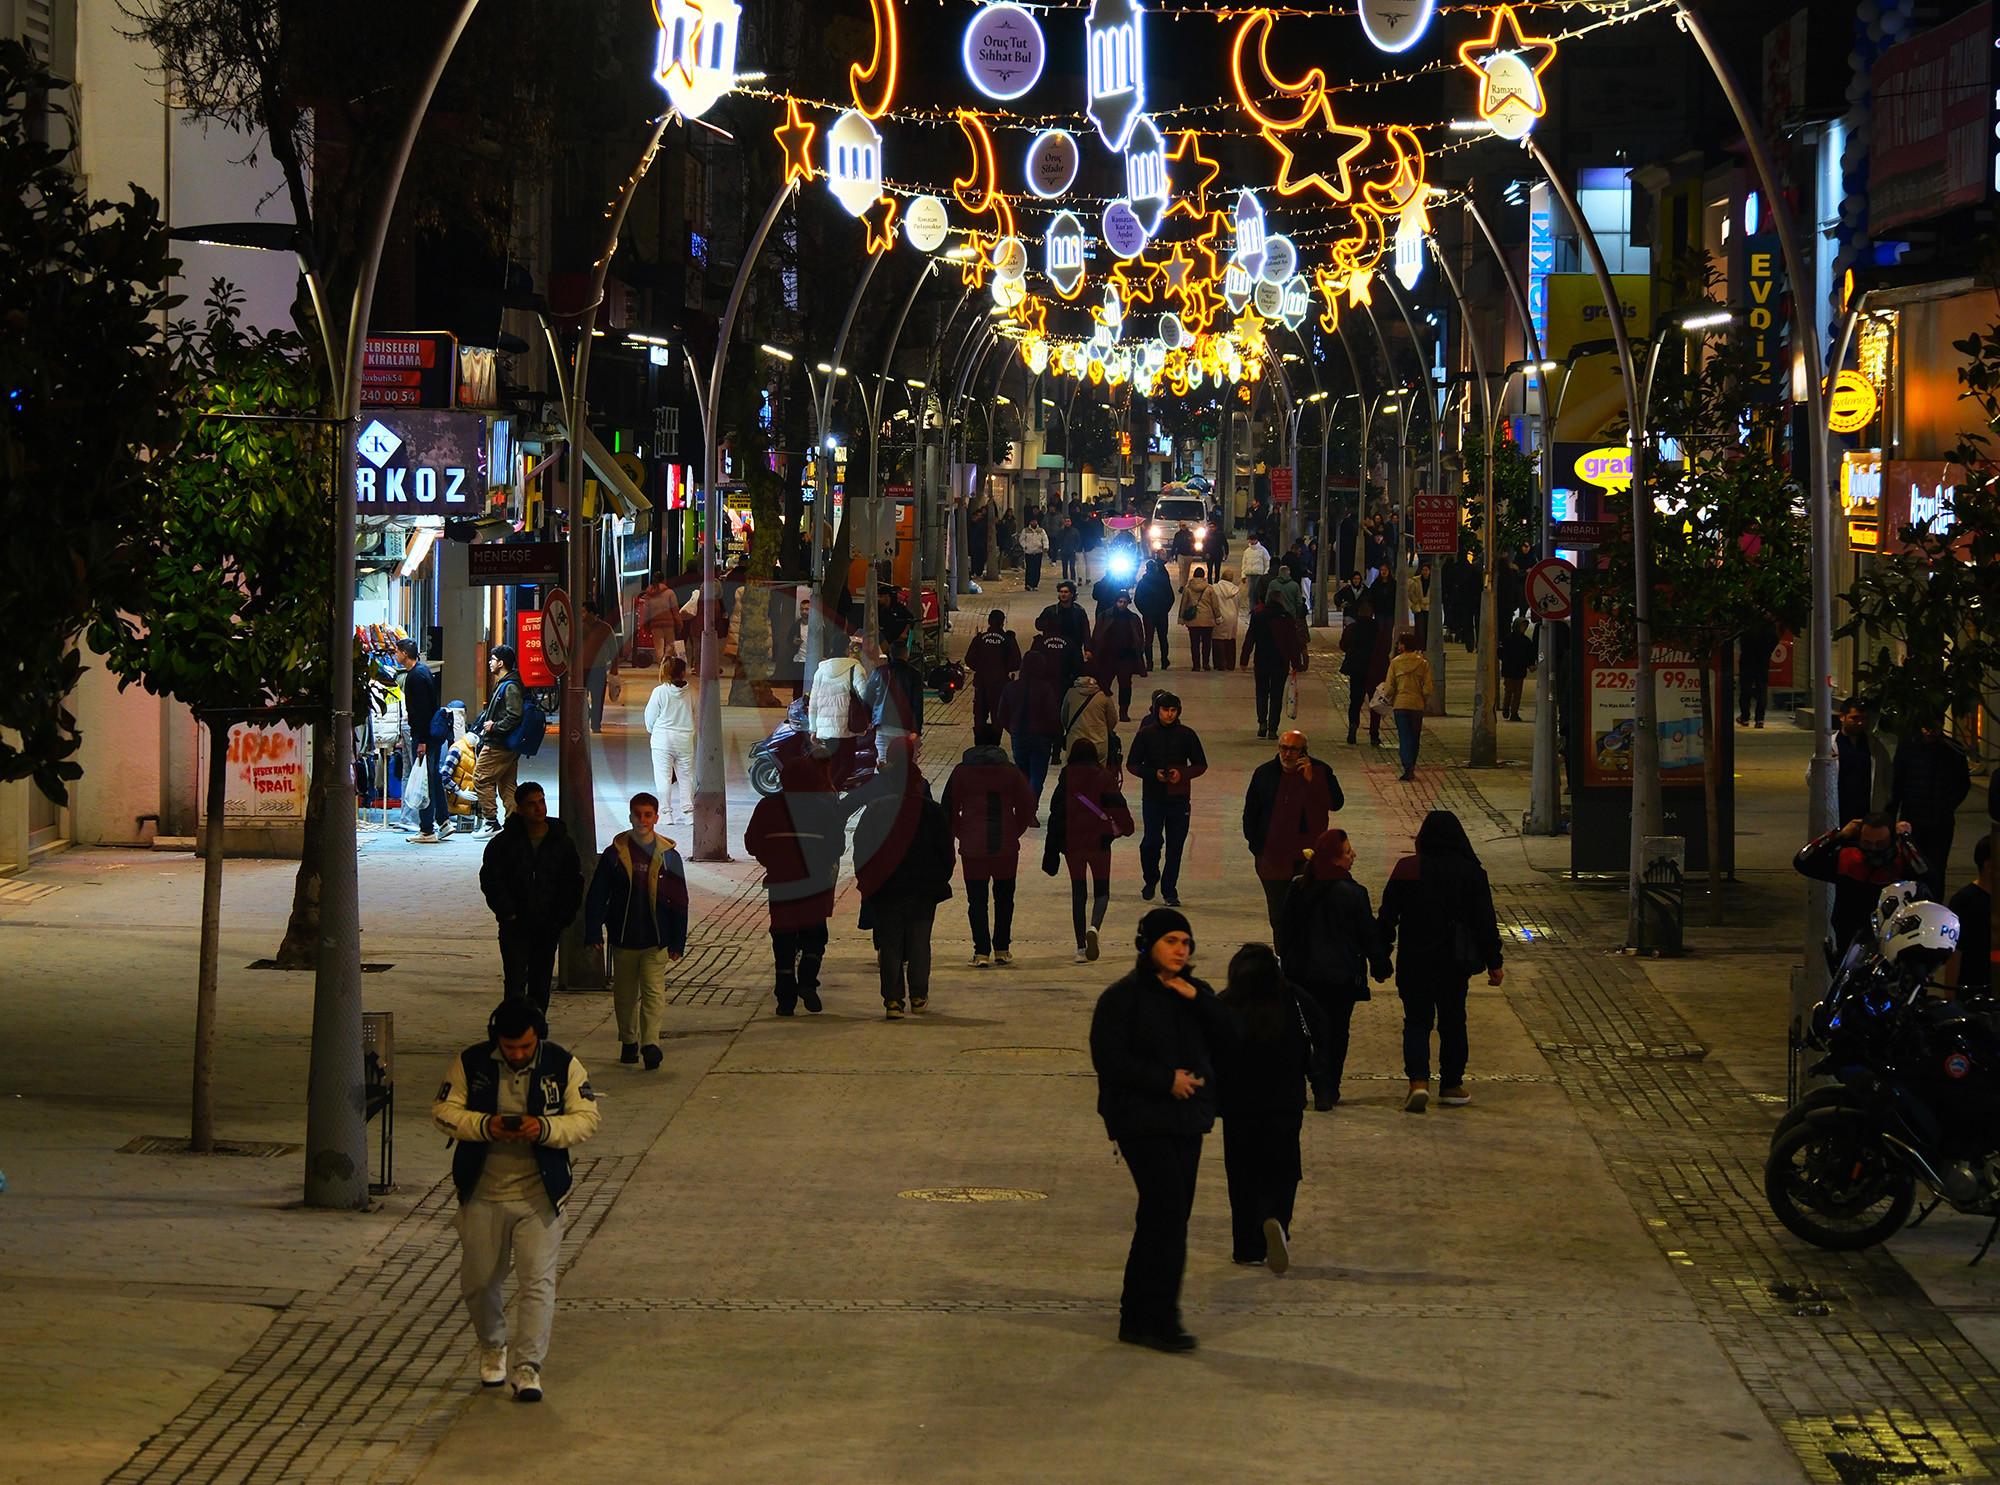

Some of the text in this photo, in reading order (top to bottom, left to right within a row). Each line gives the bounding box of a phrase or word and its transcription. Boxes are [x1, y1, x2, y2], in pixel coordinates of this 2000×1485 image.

[983, 35, 1027, 50] Oruç Tut
[979, 49, 1031, 63] Sıhhat Bul
[1491, 84, 1522, 94] Ramazan
[1045, 153, 1063, 164] Oruç
[1583, 301, 1637, 322] grais
[364, 341, 420, 354] ELBİSELERİ
[368, 353, 421, 366] KİRALAMA
[361, 389, 415, 402] 240 00 54
[1831, 396, 1871, 409] aydonoz
[474, 549, 532, 563] MENEKŞE
[1595, 672, 1636, 690] 229,9
[253, 776, 296, 794] İSRAİL
